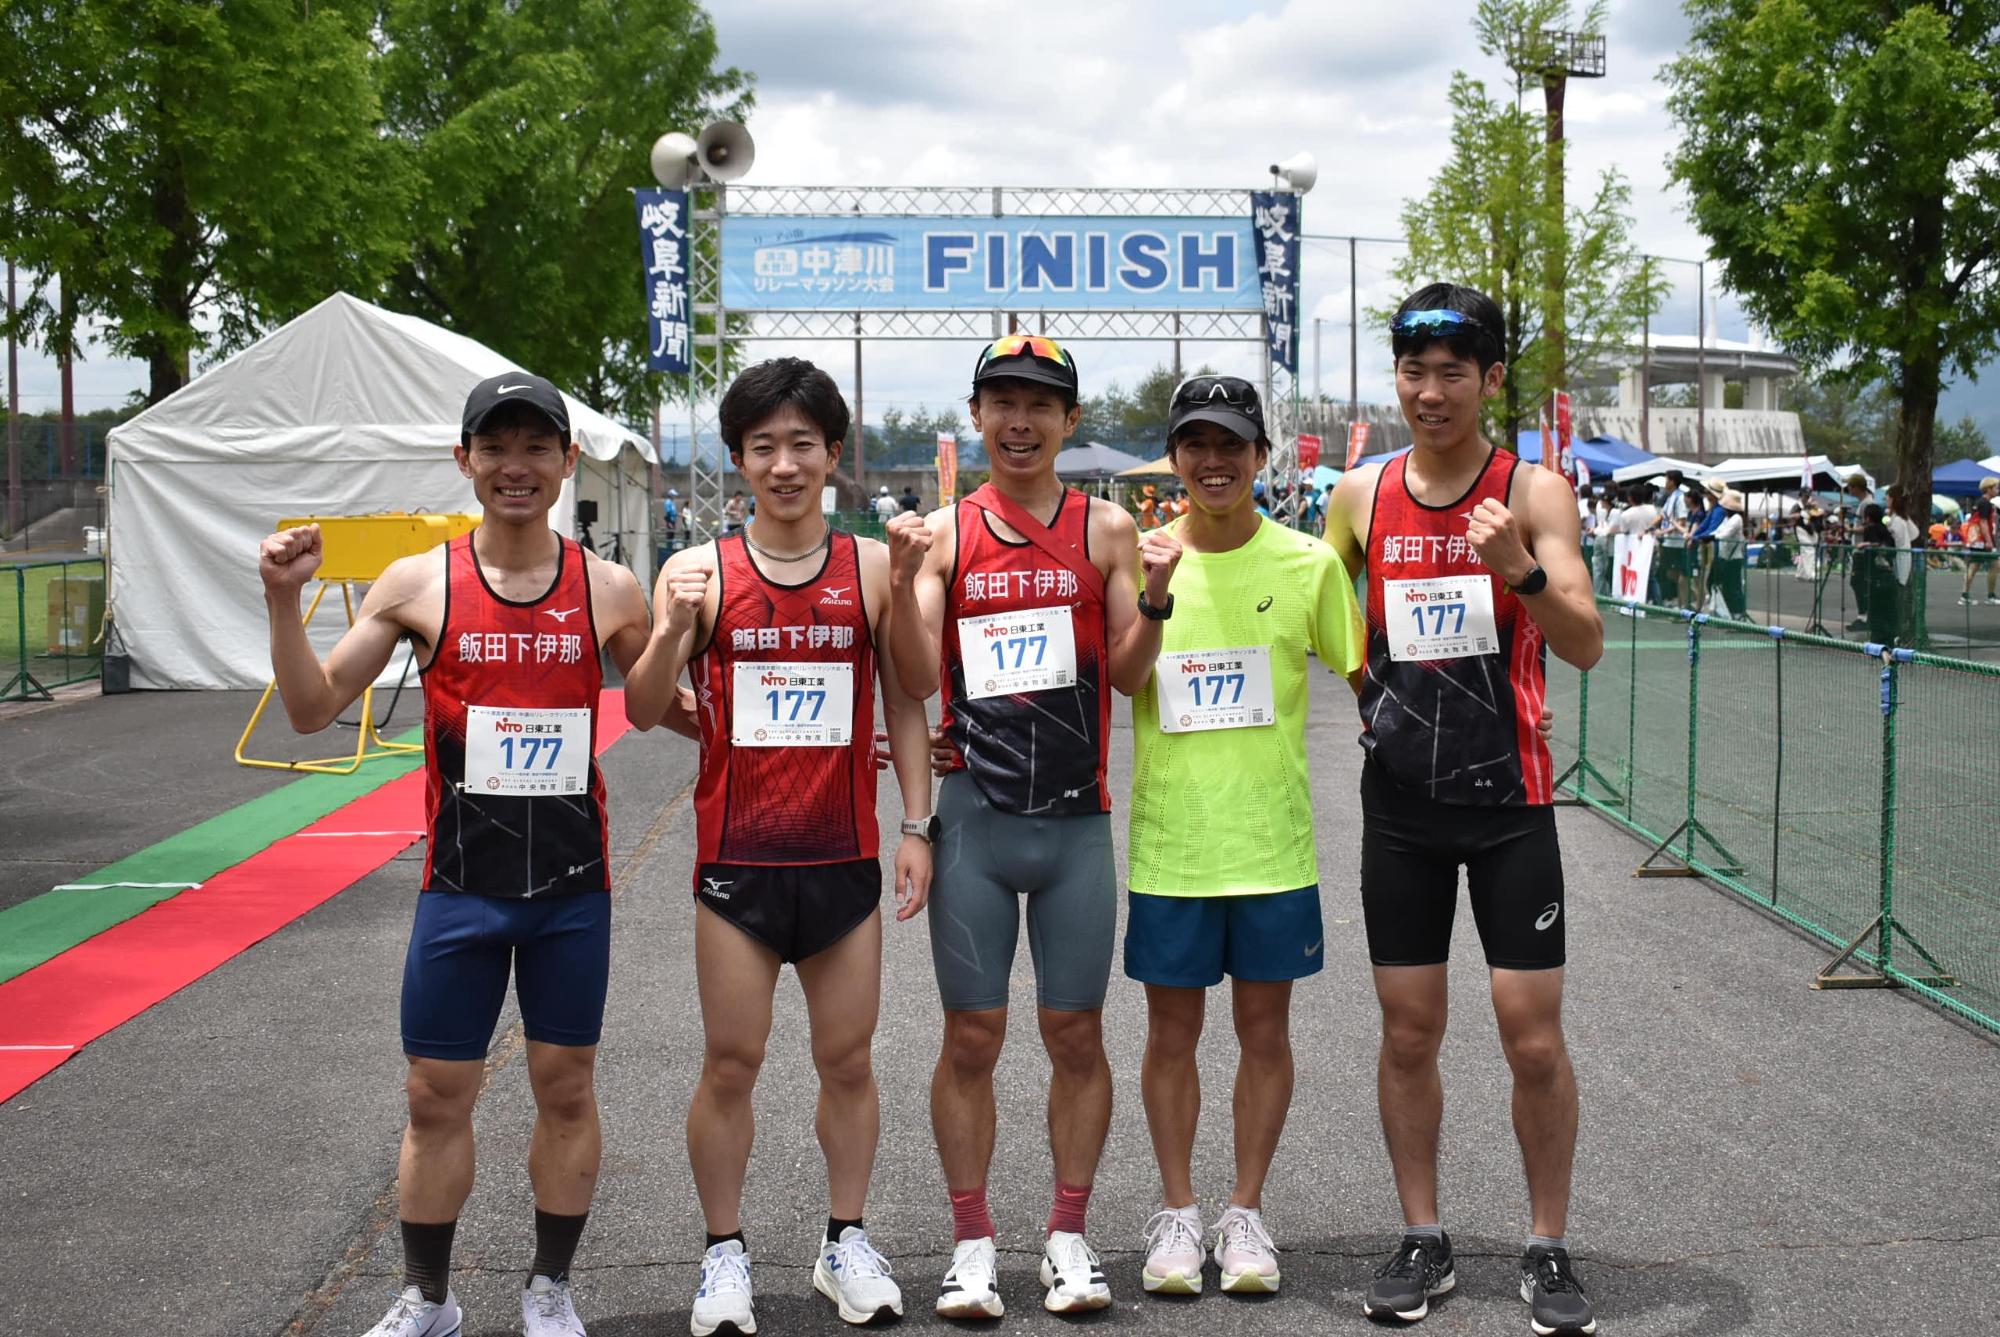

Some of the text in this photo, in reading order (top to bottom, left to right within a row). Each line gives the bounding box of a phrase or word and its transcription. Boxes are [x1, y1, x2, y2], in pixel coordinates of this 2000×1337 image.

[802, 245, 894, 276] 中津川
[923, 231, 1238, 292] FINISH
[640, 200, 688, 365] 岐阜新聞
[754, 277, 894, 293] リレーマラソン大会
[964, 568, 1078, 601] 飯田下伊那
[1429, 591, 1463, 601] 日東工業
[1010, 623, 1045, 635] 日東工業
[1411, 603, 1466, 636] 177
[458, 632, 582, 664] 飯田下伊那
[731, 624, 854, 651] 飯田下伊那
[991, 635, 1048, 671] 177
[790, 677, 825, 686] 日東工業
[1209, 661, 1243, 671] 日東工業
[1188, 673, 1245, 706] 177
[766, 690, 826, 721] 177
[526, 724, 562, 733] 日東工業
[500, 737, 563, 769] 177
